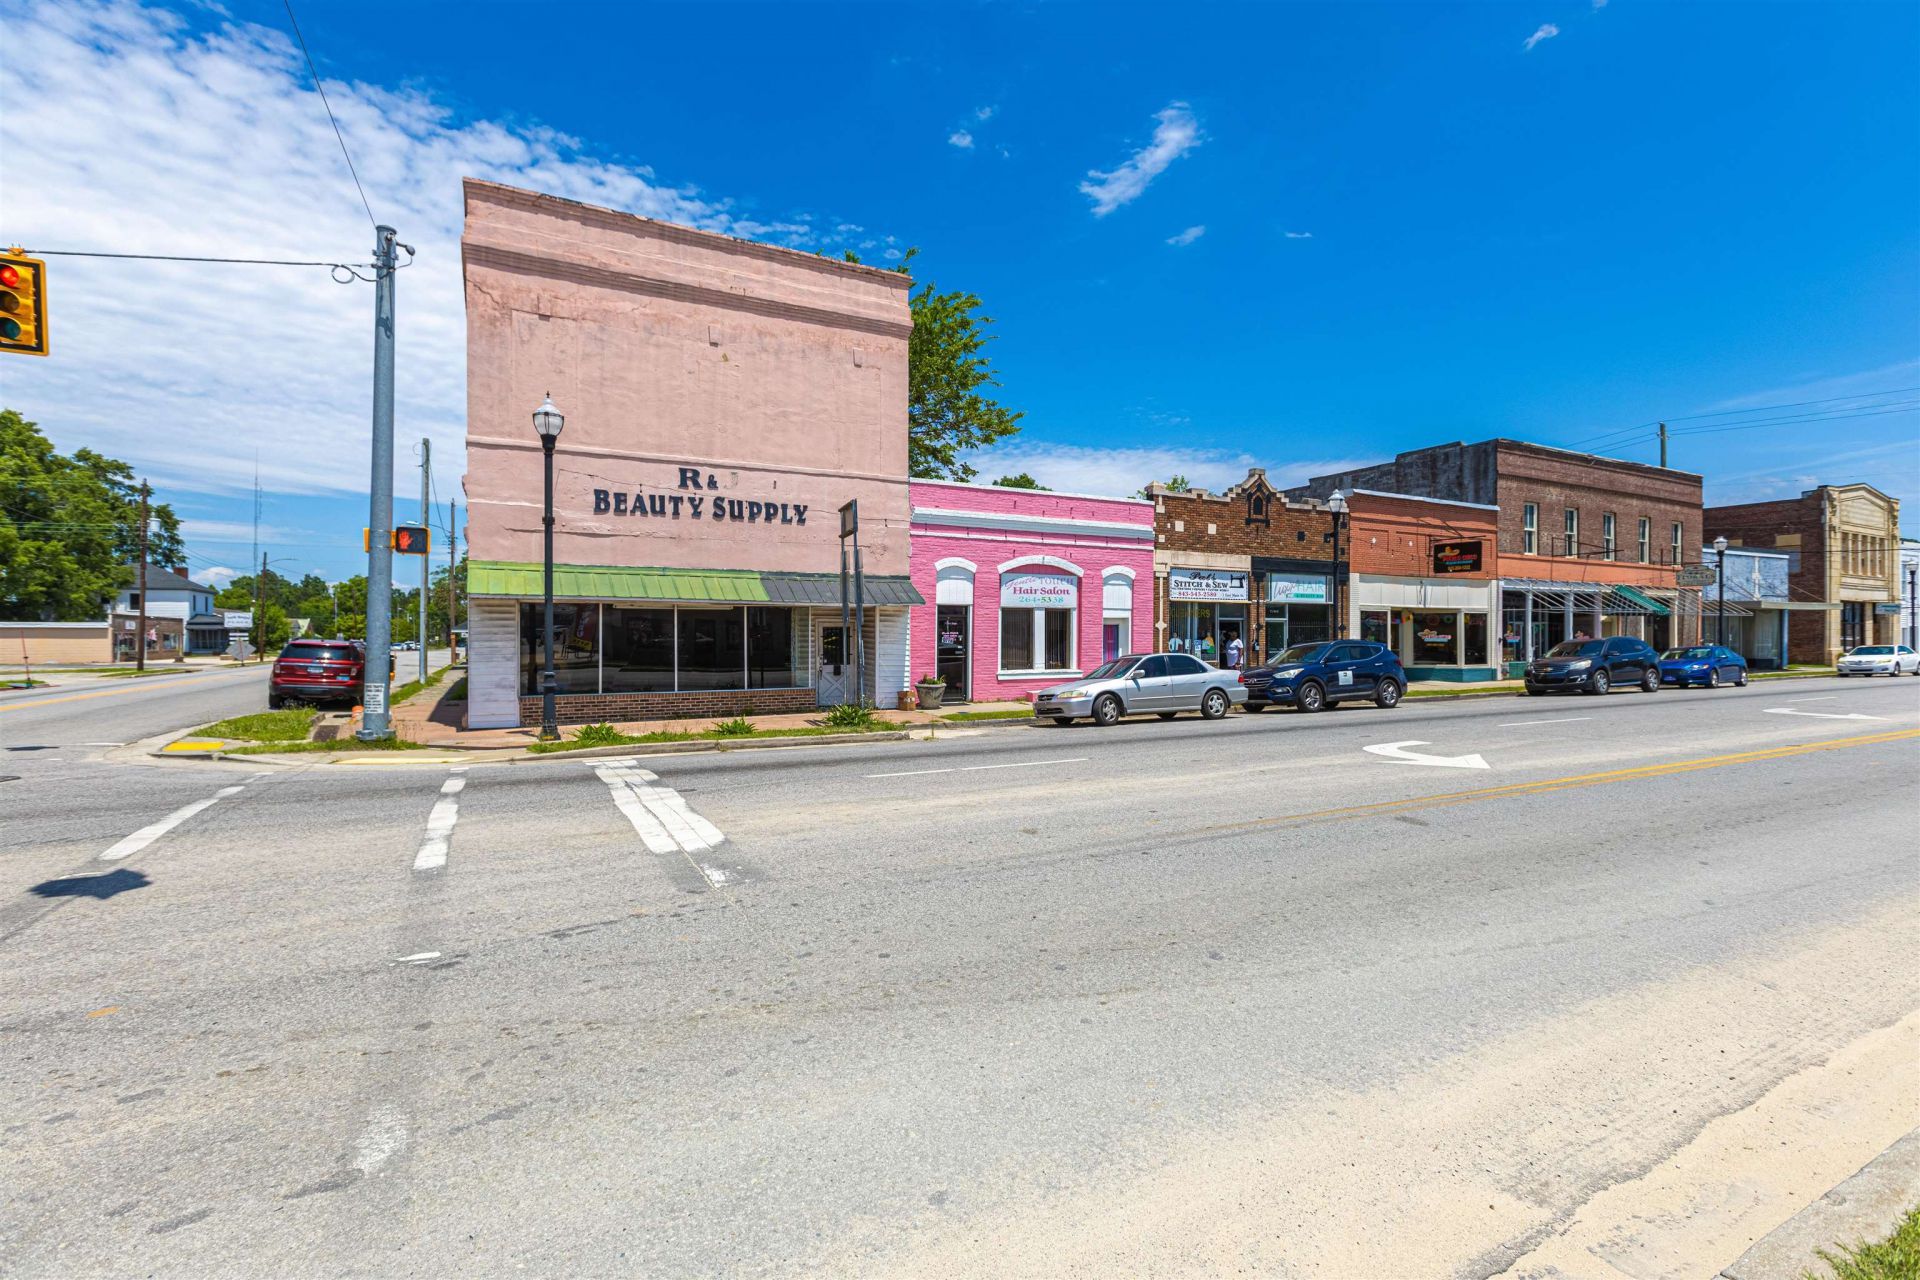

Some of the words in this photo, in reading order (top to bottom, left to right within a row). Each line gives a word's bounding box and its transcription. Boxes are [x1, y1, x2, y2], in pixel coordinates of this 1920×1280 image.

[678, 467, 703, 490] R
[707, 474, 719, 490] &
[593, 488, 705, 519] BEAUTY
[712, 496, 808, 526] SUPPLY
[1013, 586, 1039, 595] Hair
[1040, 586, 1071, 596] Salon
